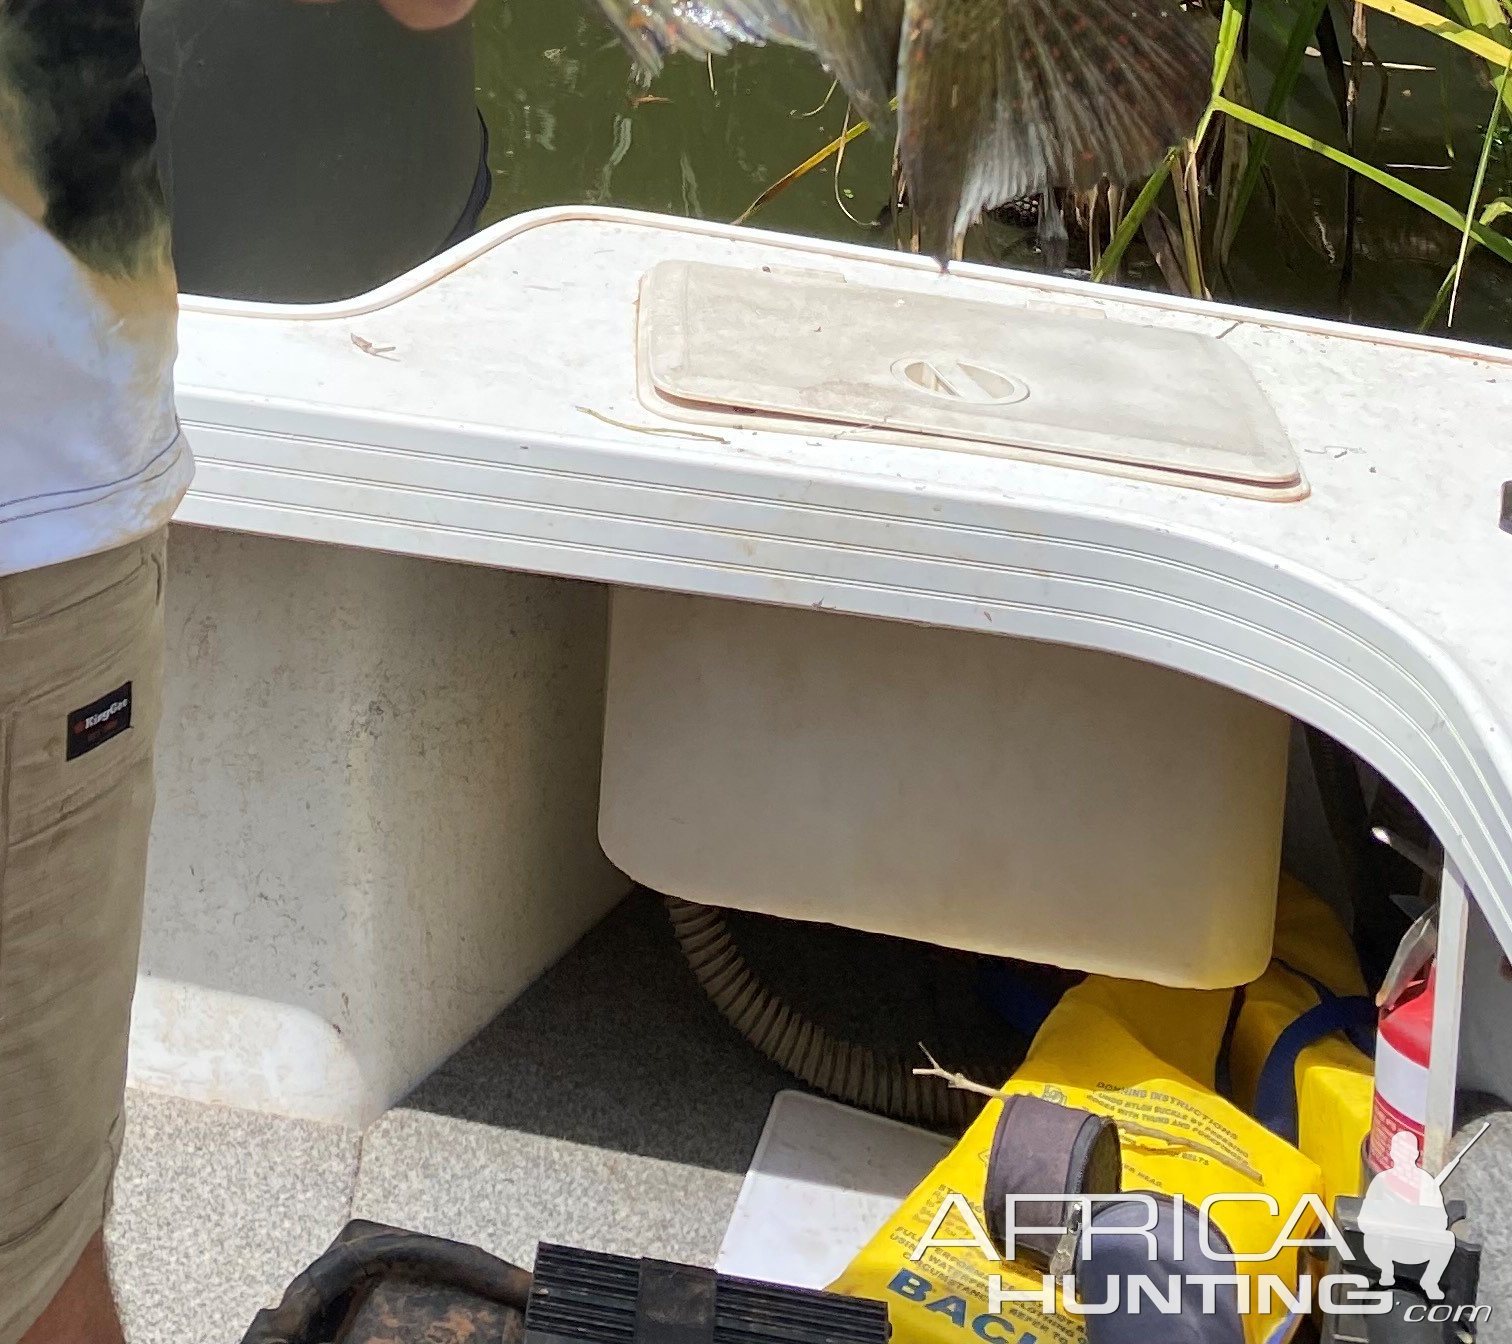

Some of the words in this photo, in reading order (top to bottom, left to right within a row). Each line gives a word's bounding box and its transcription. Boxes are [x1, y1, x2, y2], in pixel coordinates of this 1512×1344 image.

[1150, 1091, 1238, 1140] INSTRUCTIONS
[1154, 1106, 1189, 1120] BUCKLE
[889, 1233, 917, 1251] USIN
[887, 1268, 1036, 1344] BAC
